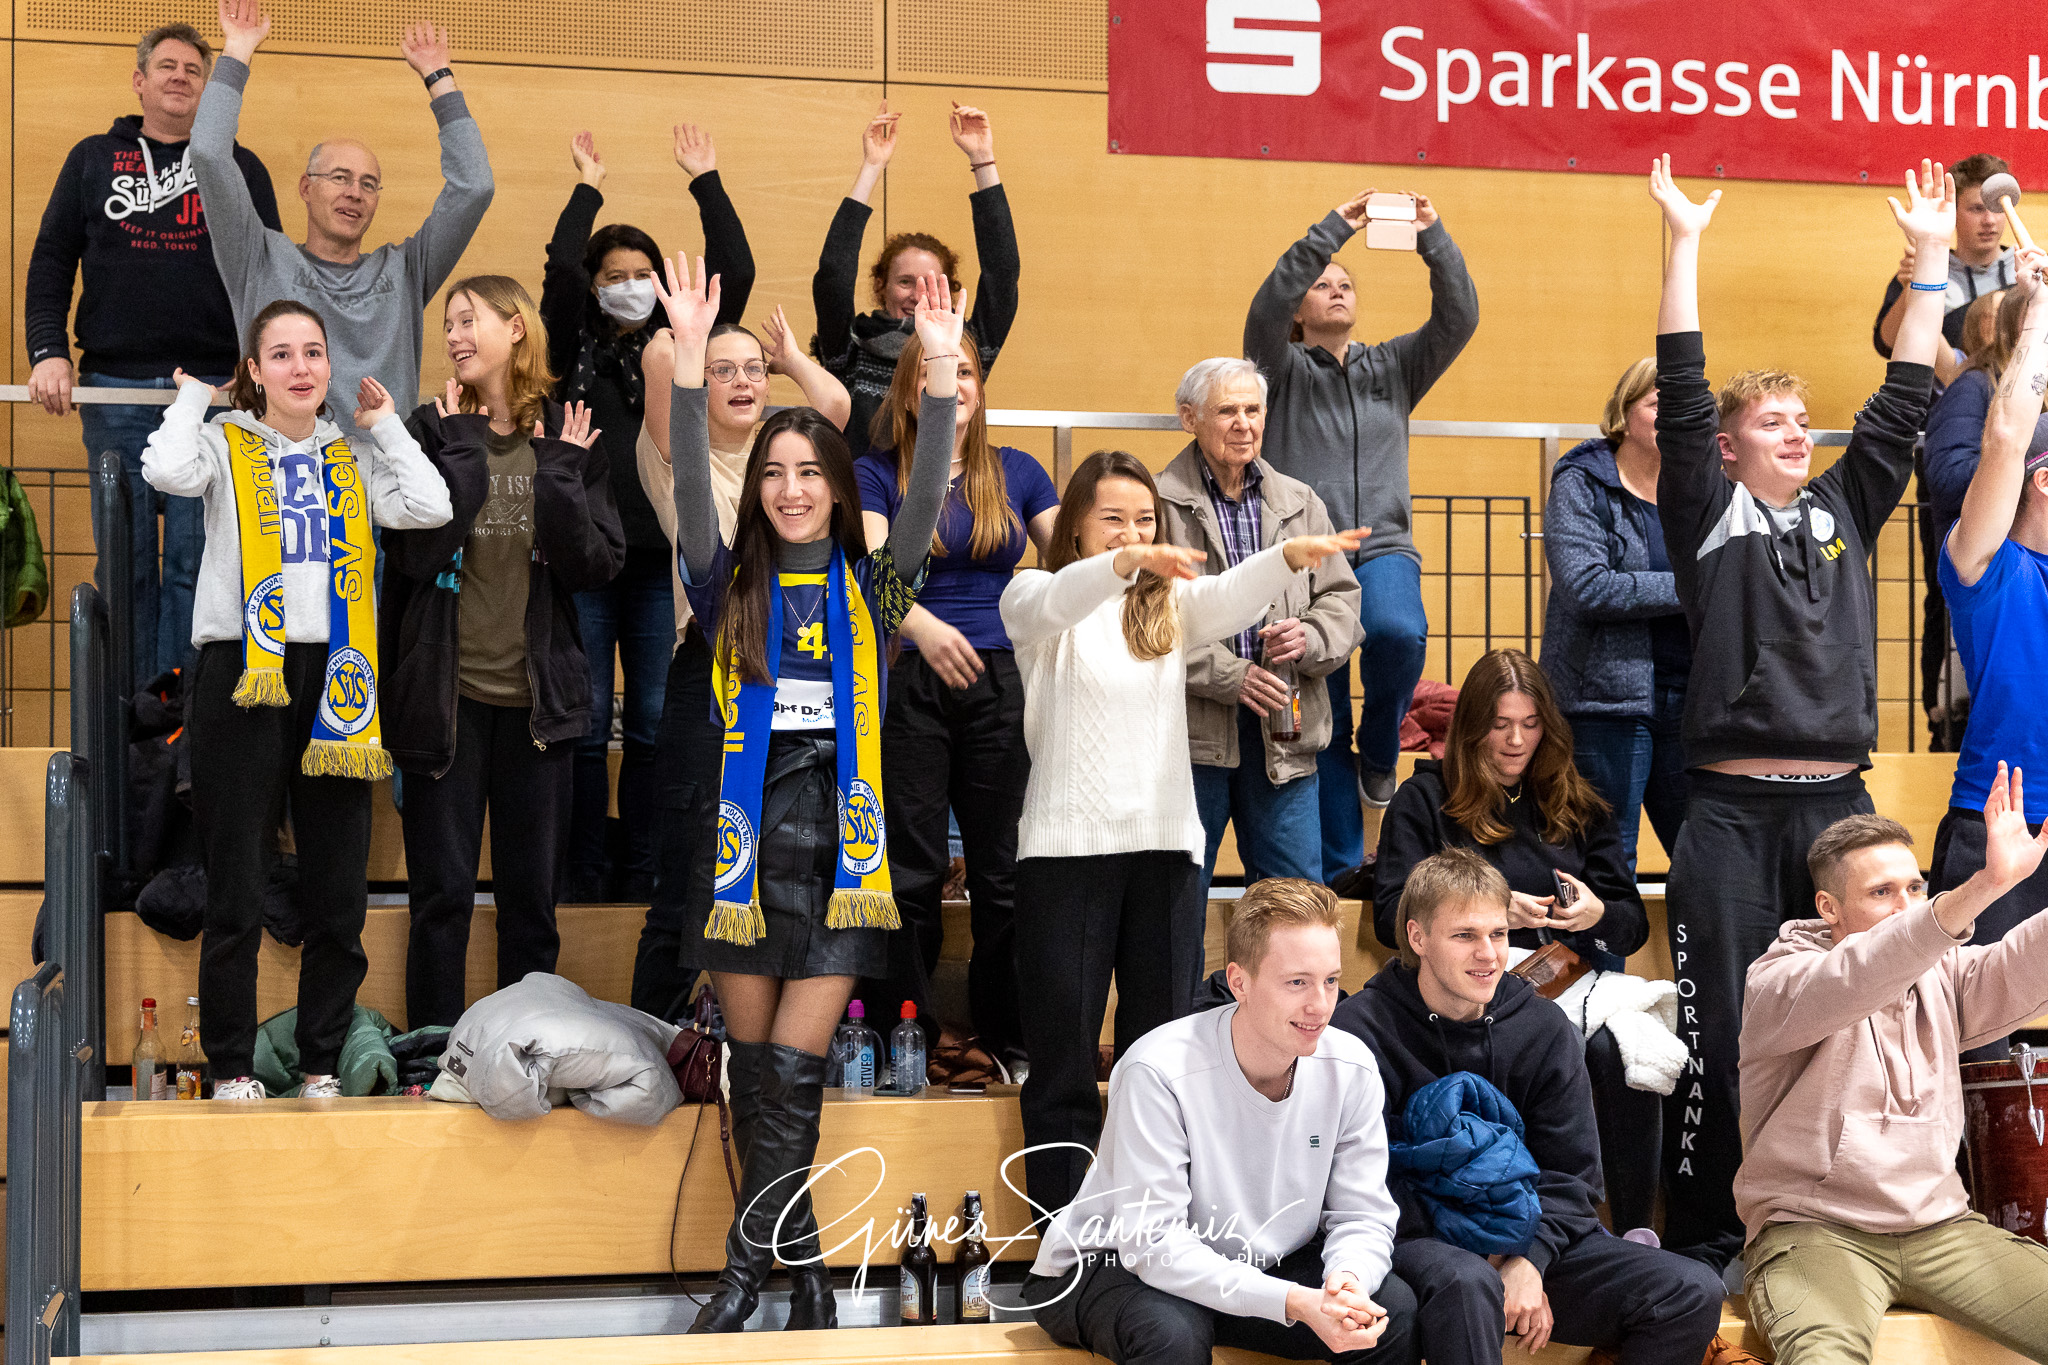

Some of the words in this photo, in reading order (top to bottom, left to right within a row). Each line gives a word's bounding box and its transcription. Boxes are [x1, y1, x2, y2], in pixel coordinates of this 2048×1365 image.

[1379, 25, 1801, 123] Sparkasse
[1831, 48, 2048, 131] Nürnb
[113, 161, 157, 173] REA
[114, 151, 142, 161] THE
[120, 220, 143, 235] KEEP
[165, 242, 198, 251] TOKYO
[1820, 537, 1847, 561] LM
[331, 538, 363, 602] SV
[798, 622, 828, 660] 4
[725, 807, 750, 850] VOLLEYBALL
[1676, 924, 1704, 1176] SPORTNANKA
